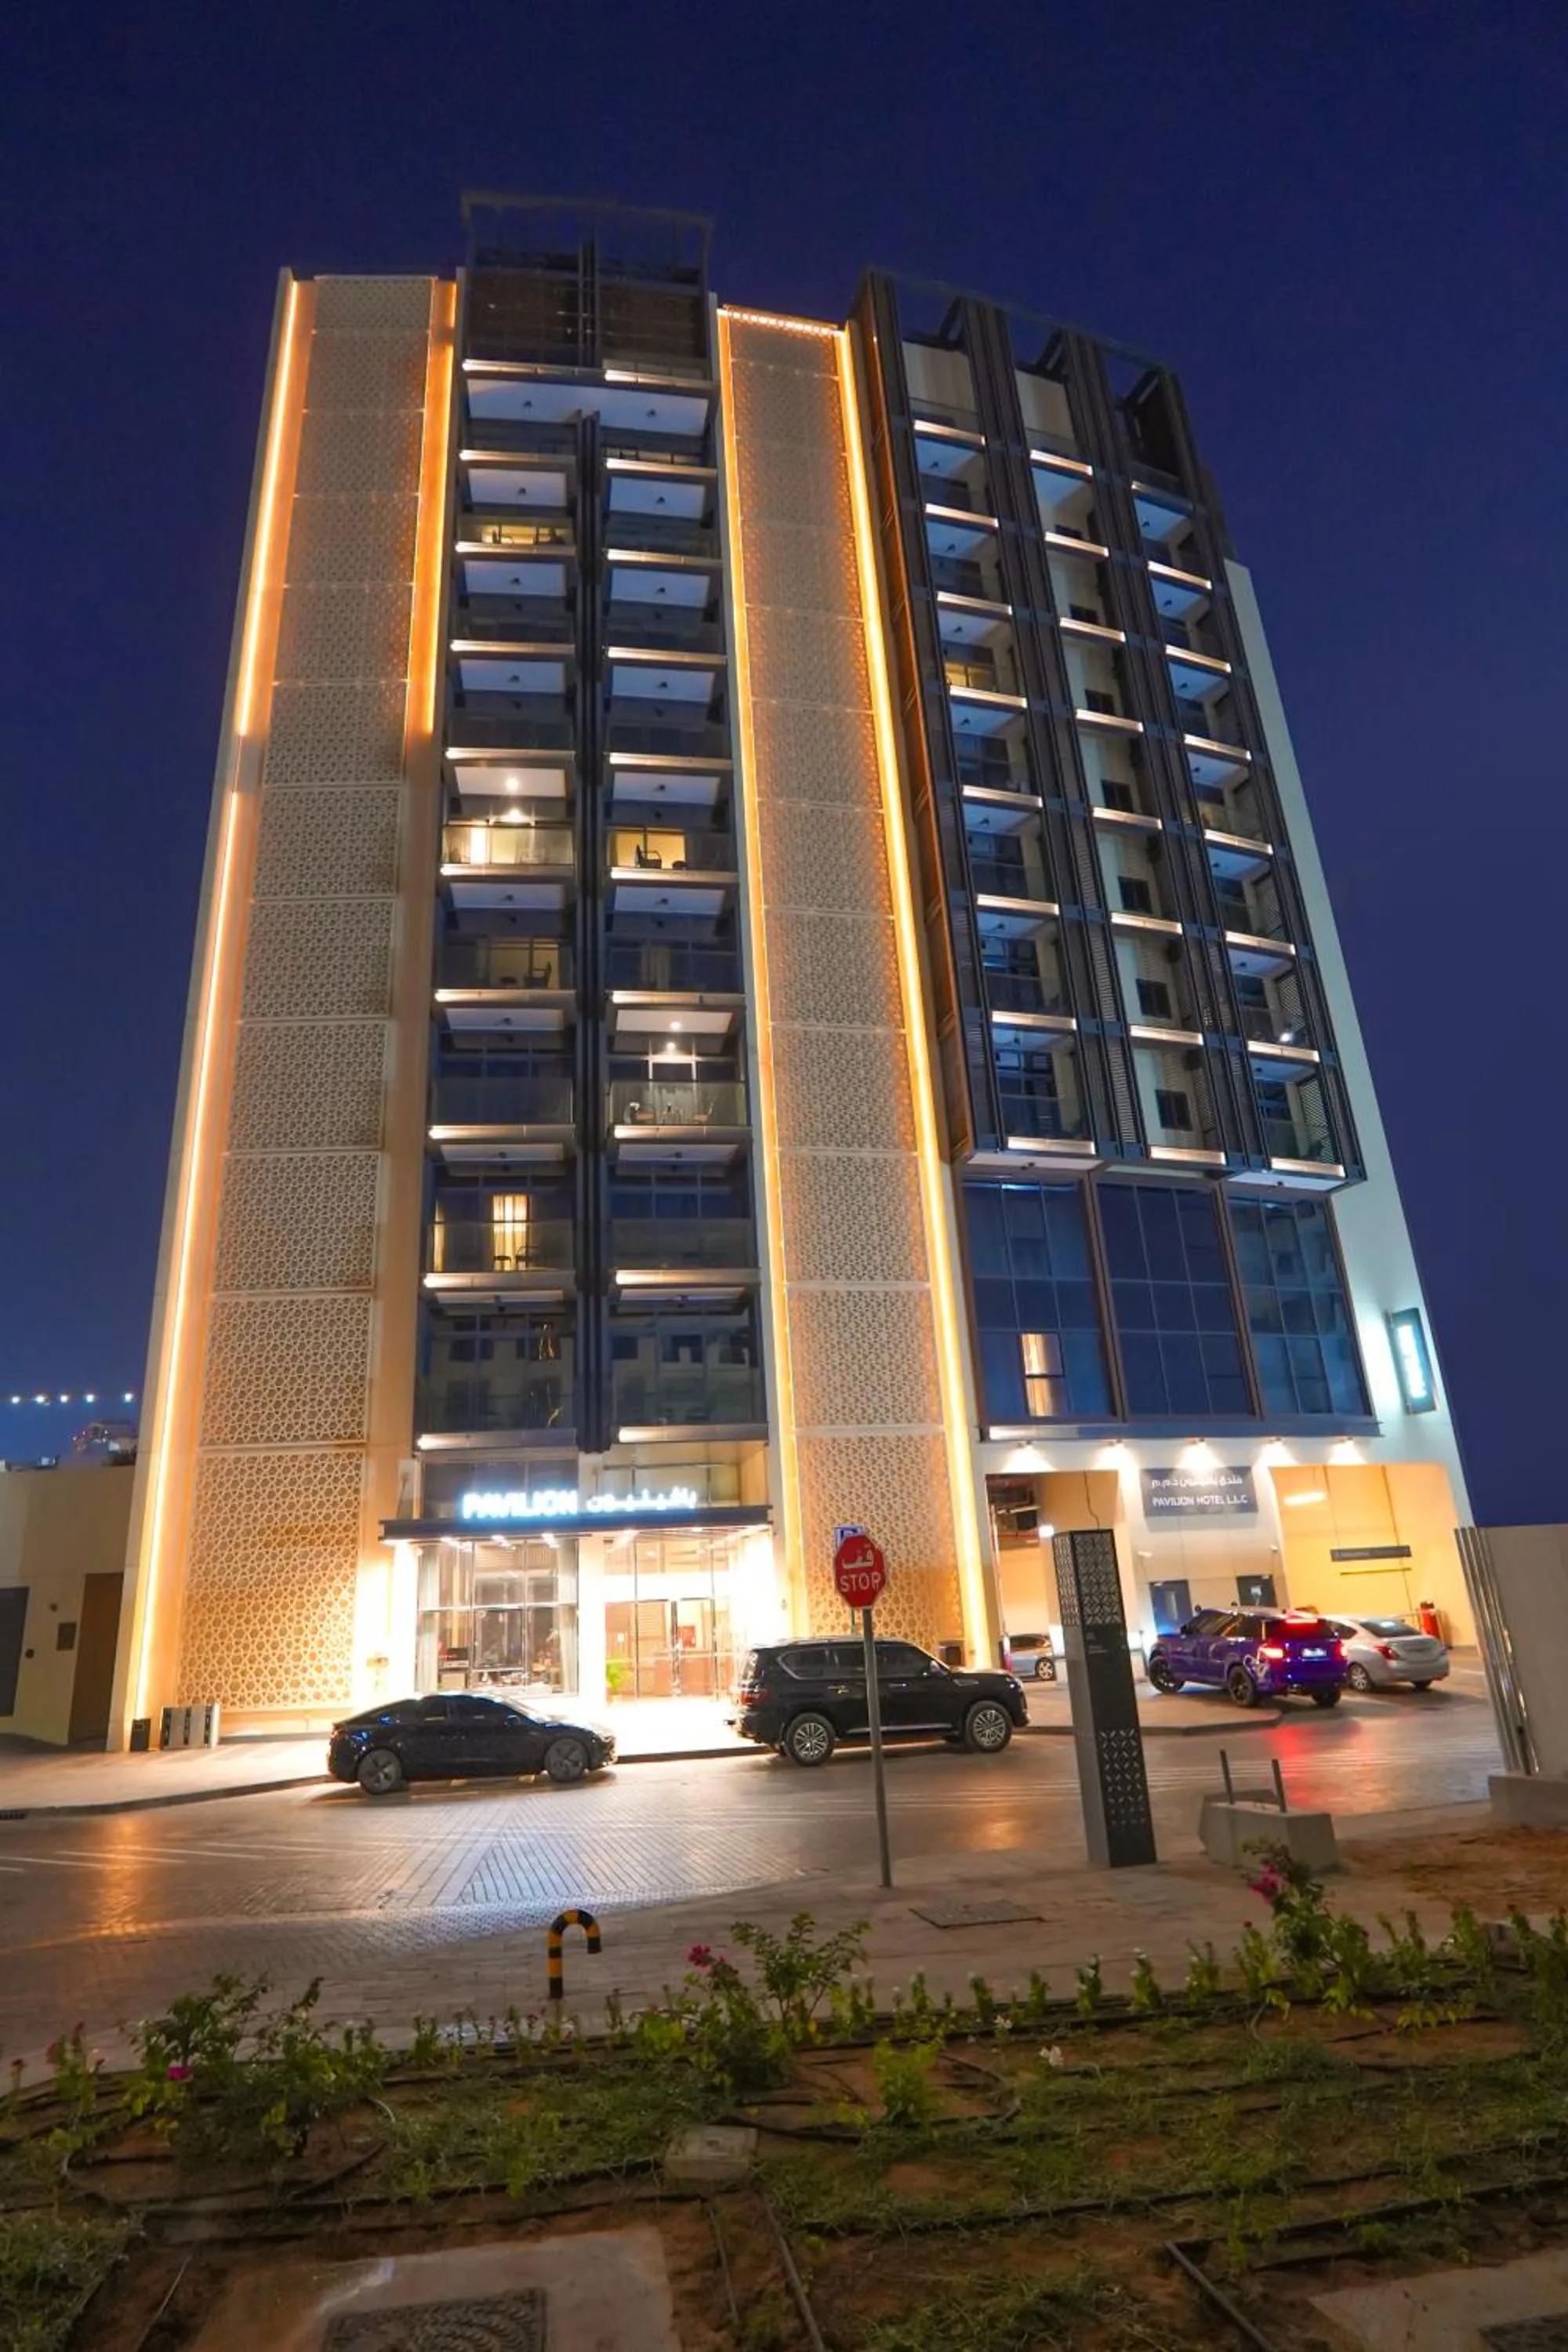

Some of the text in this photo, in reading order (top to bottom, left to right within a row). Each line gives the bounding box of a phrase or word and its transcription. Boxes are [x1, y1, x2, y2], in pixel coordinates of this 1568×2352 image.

[463, 1490, 578, 1519] PAVILION
[1152, 1495, 1194, 1507] PAVILION
[1196, 1495, 1225, 1505] HOTEL
[842, 1542, 874, 1569] قف
[840, 1571, 881, 1592] STOP
